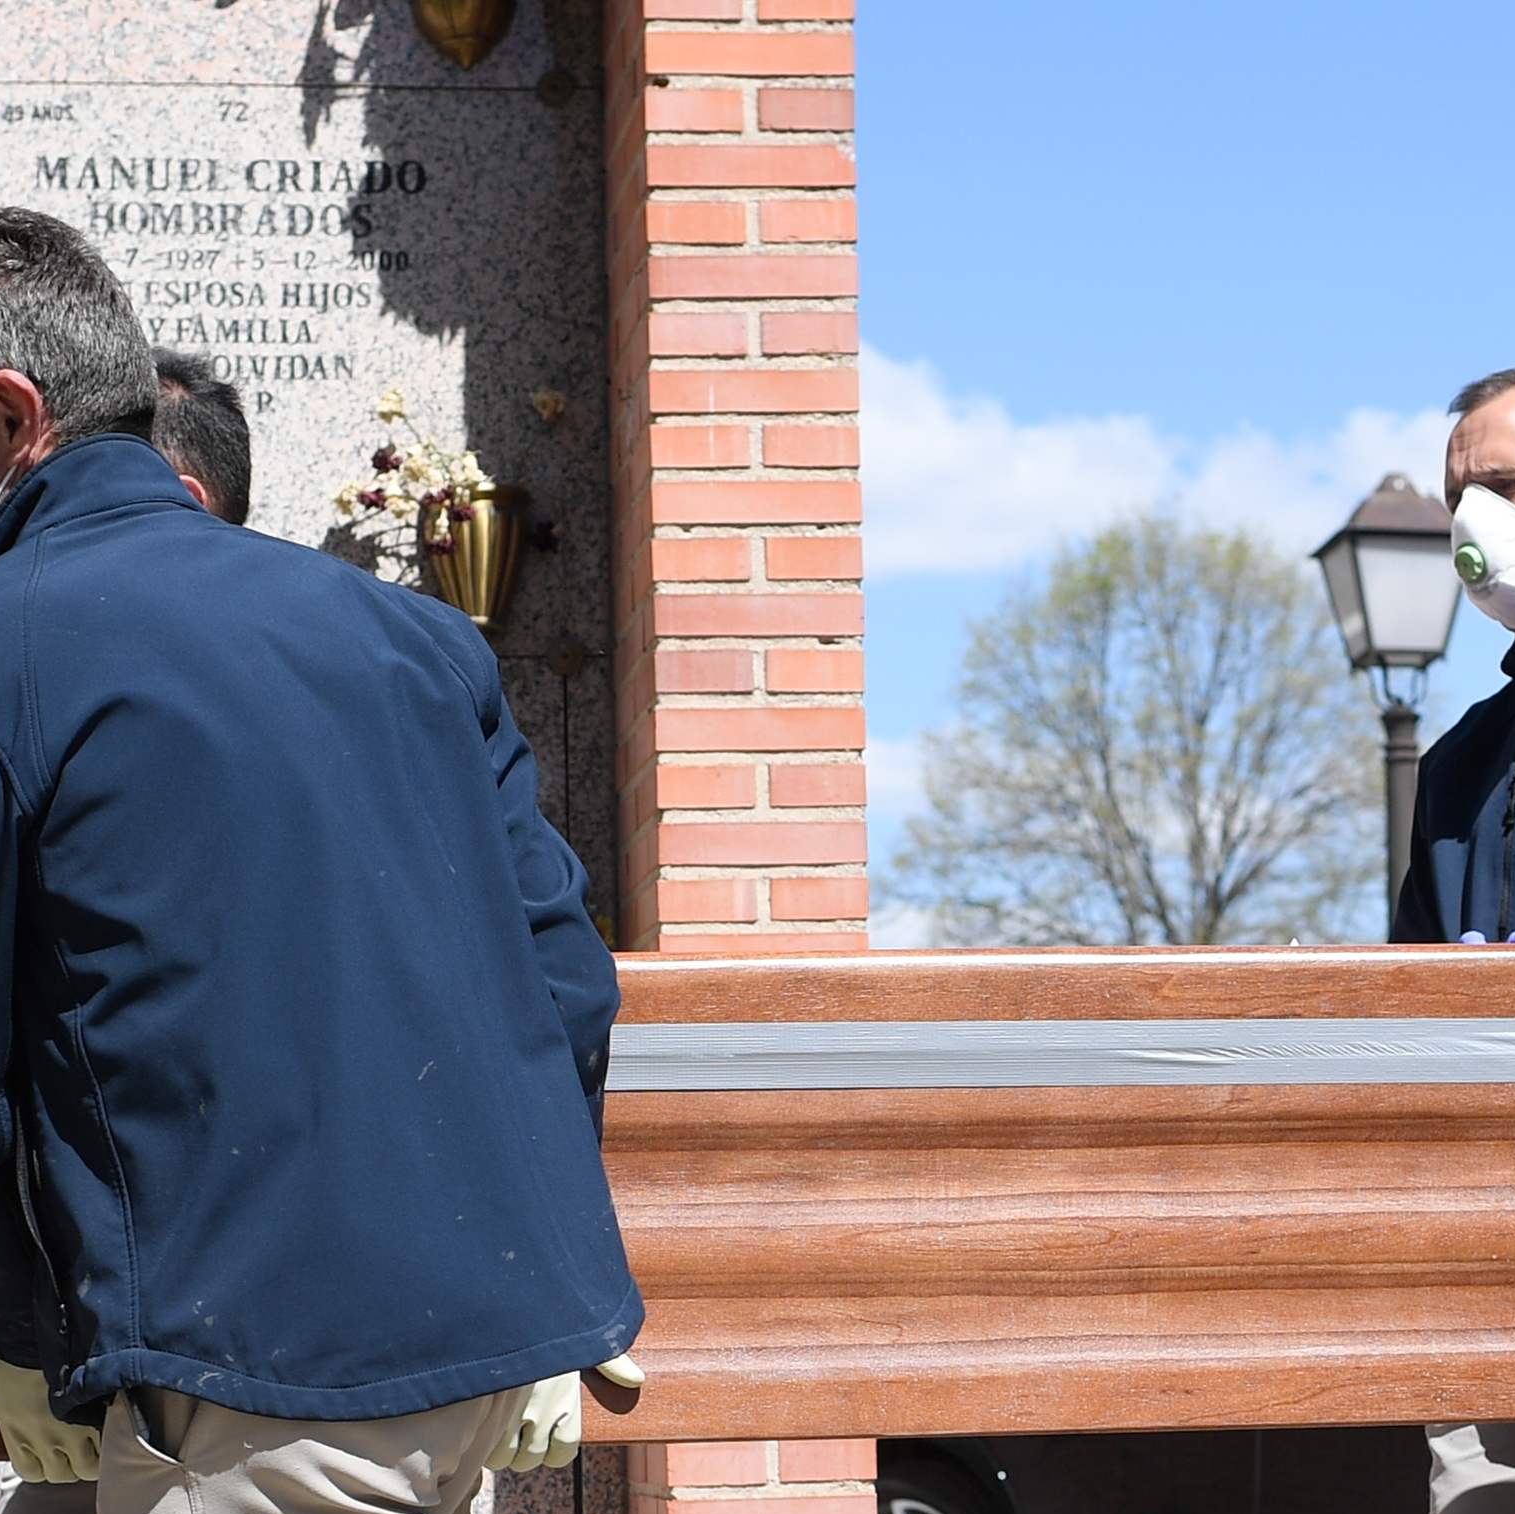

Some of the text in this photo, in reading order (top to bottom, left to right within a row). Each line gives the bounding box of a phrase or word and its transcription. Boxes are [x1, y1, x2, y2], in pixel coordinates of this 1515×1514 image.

[218, 101, 249, 122] 72
[34, 155, 427, 196] MANUEL CRIADO
[88, 201, 374, 239] HOMBRADOS
[145, 281, 264, 308] ESPOSA
[281, 282, 372, 313] HIJOS
[147, 314, 313, 344] Y FAMILIA
[212, 355, 354, 383] OLVIDAN
